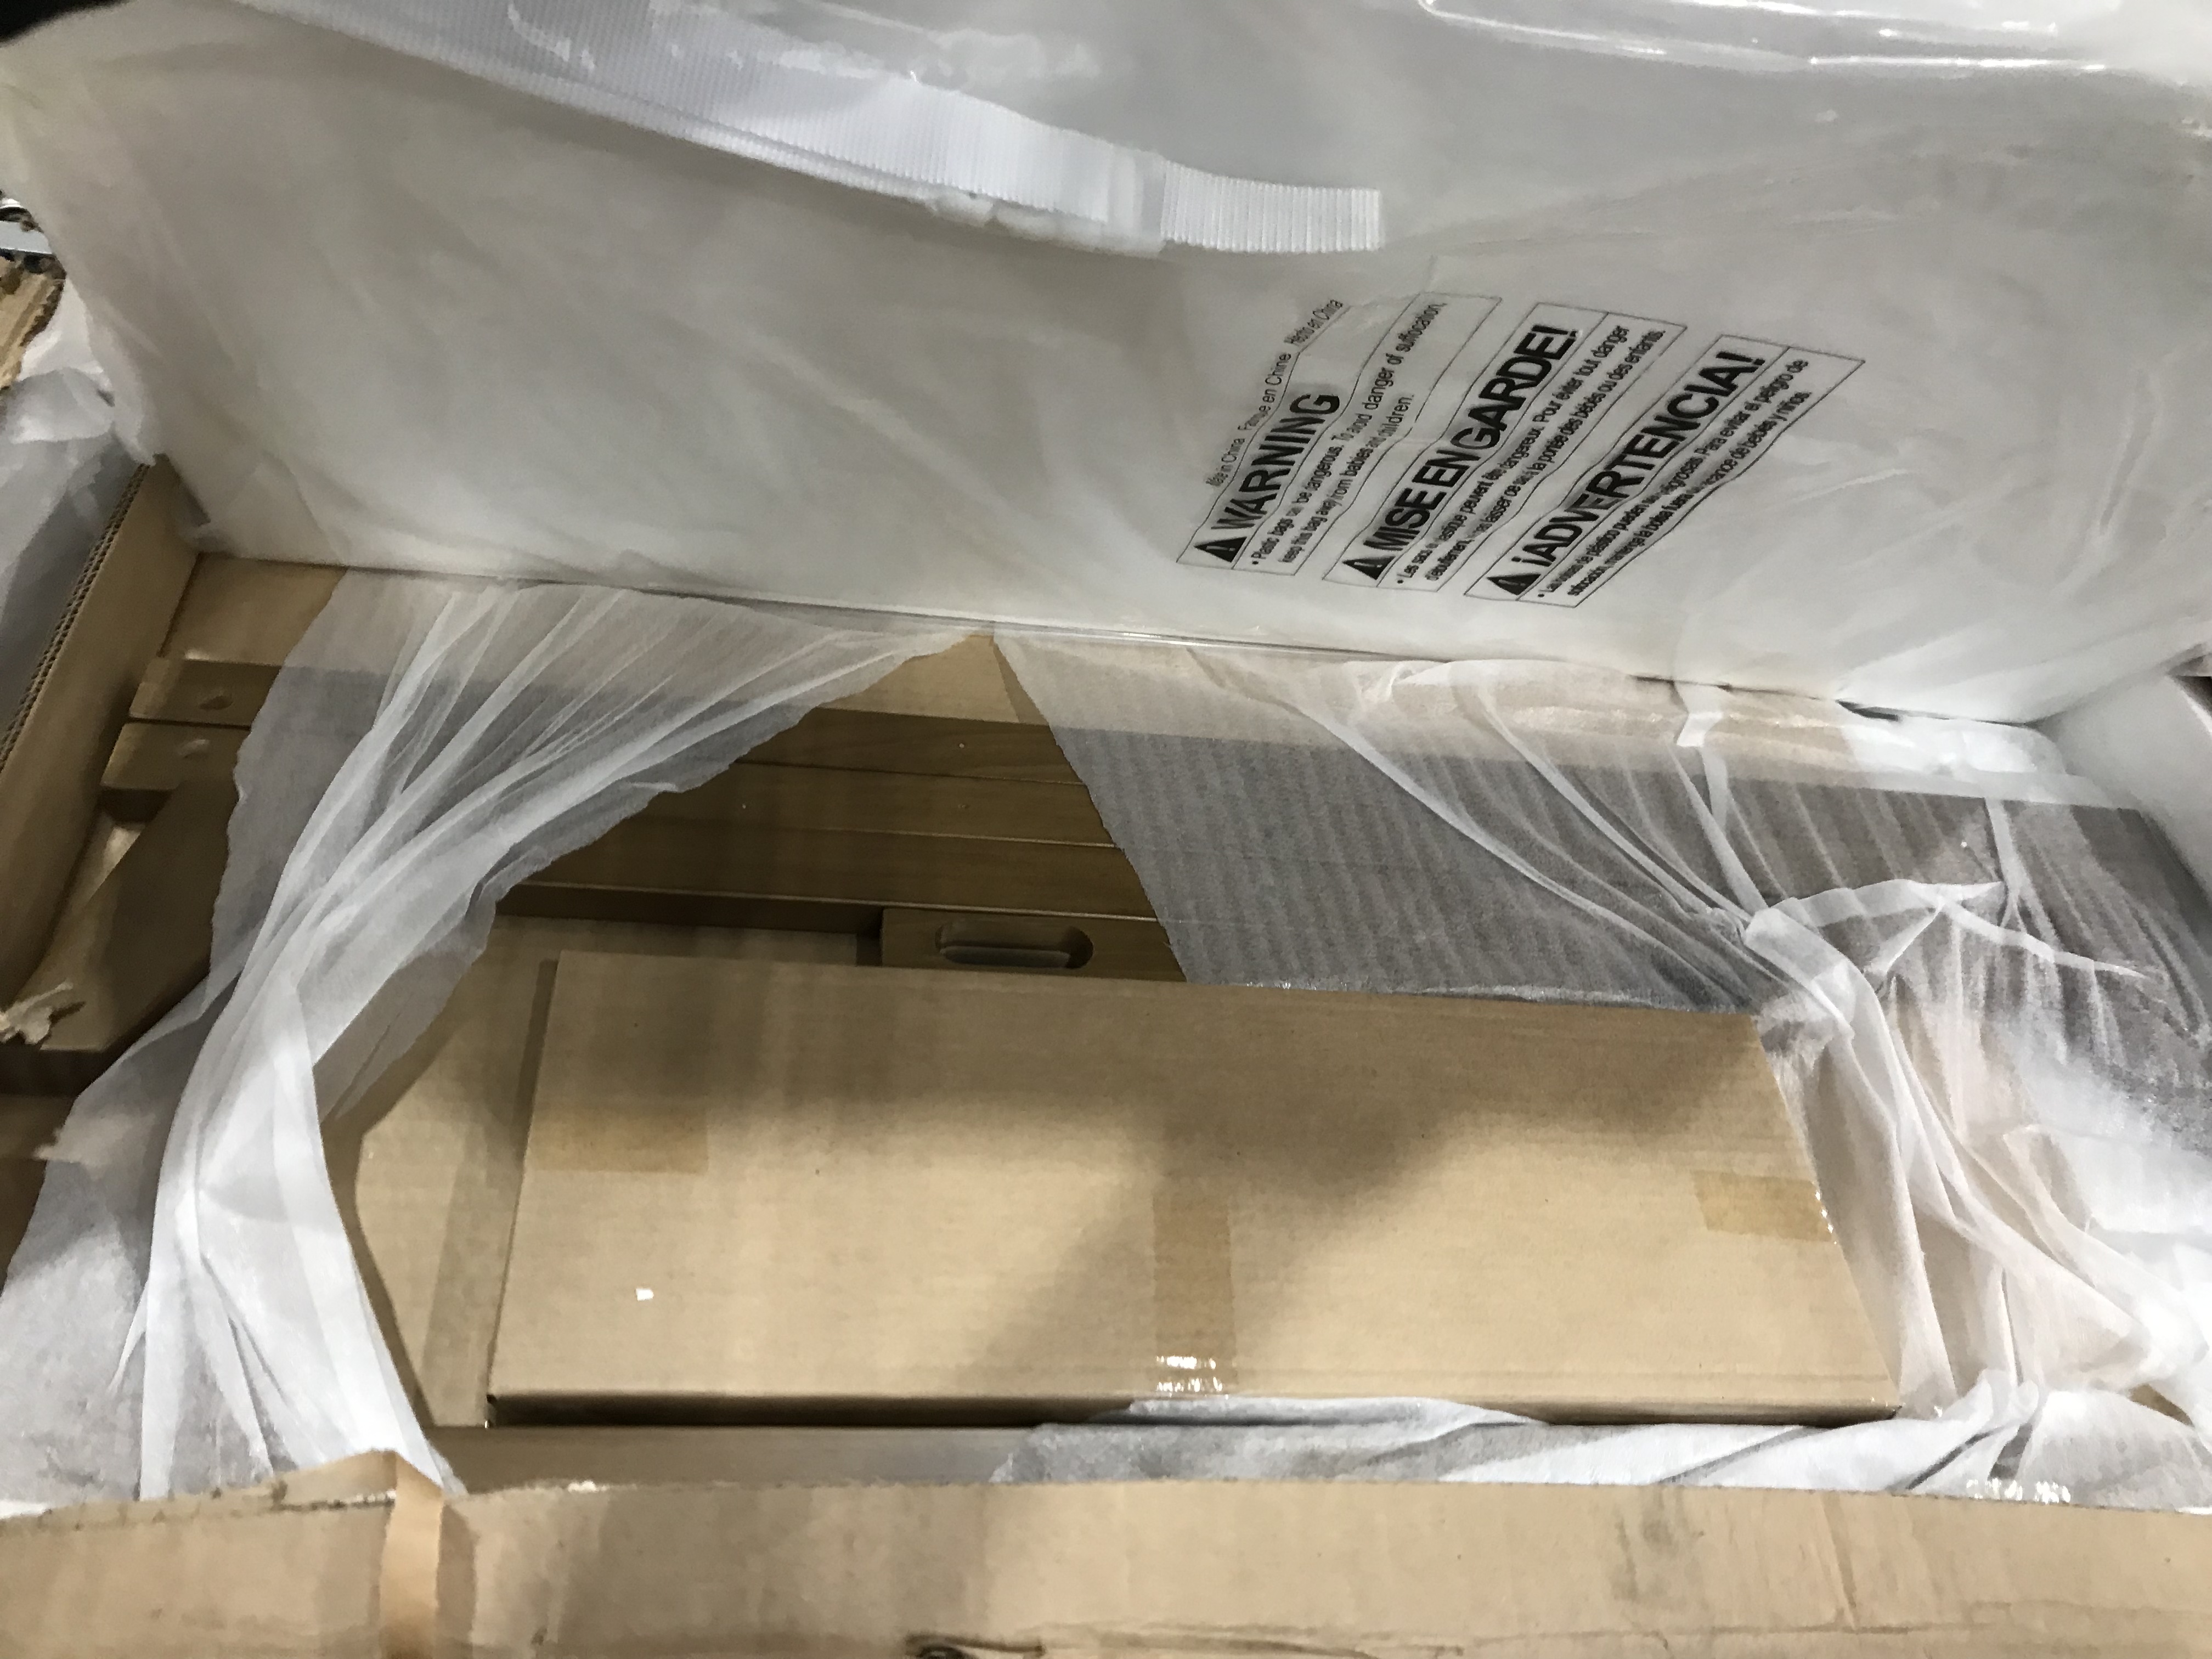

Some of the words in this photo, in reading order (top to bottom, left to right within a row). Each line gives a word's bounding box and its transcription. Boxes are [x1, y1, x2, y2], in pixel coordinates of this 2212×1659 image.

[1262, 388, 1277, 403] en
[1362, 366, 1395, 410] danger
[1385, 353, 1404, 365] of
[1532, 400, 1562, 422] Pour
[1210, 393, 1340, 530] WARNING
[1363, 488, 1448, 551] MISE
[1412, 449, 1481, 487] EN
[1449, 324, 1579, 450] GARDE!
[1511, 351, 1765, 567] ¡ADVERTENCIA!
